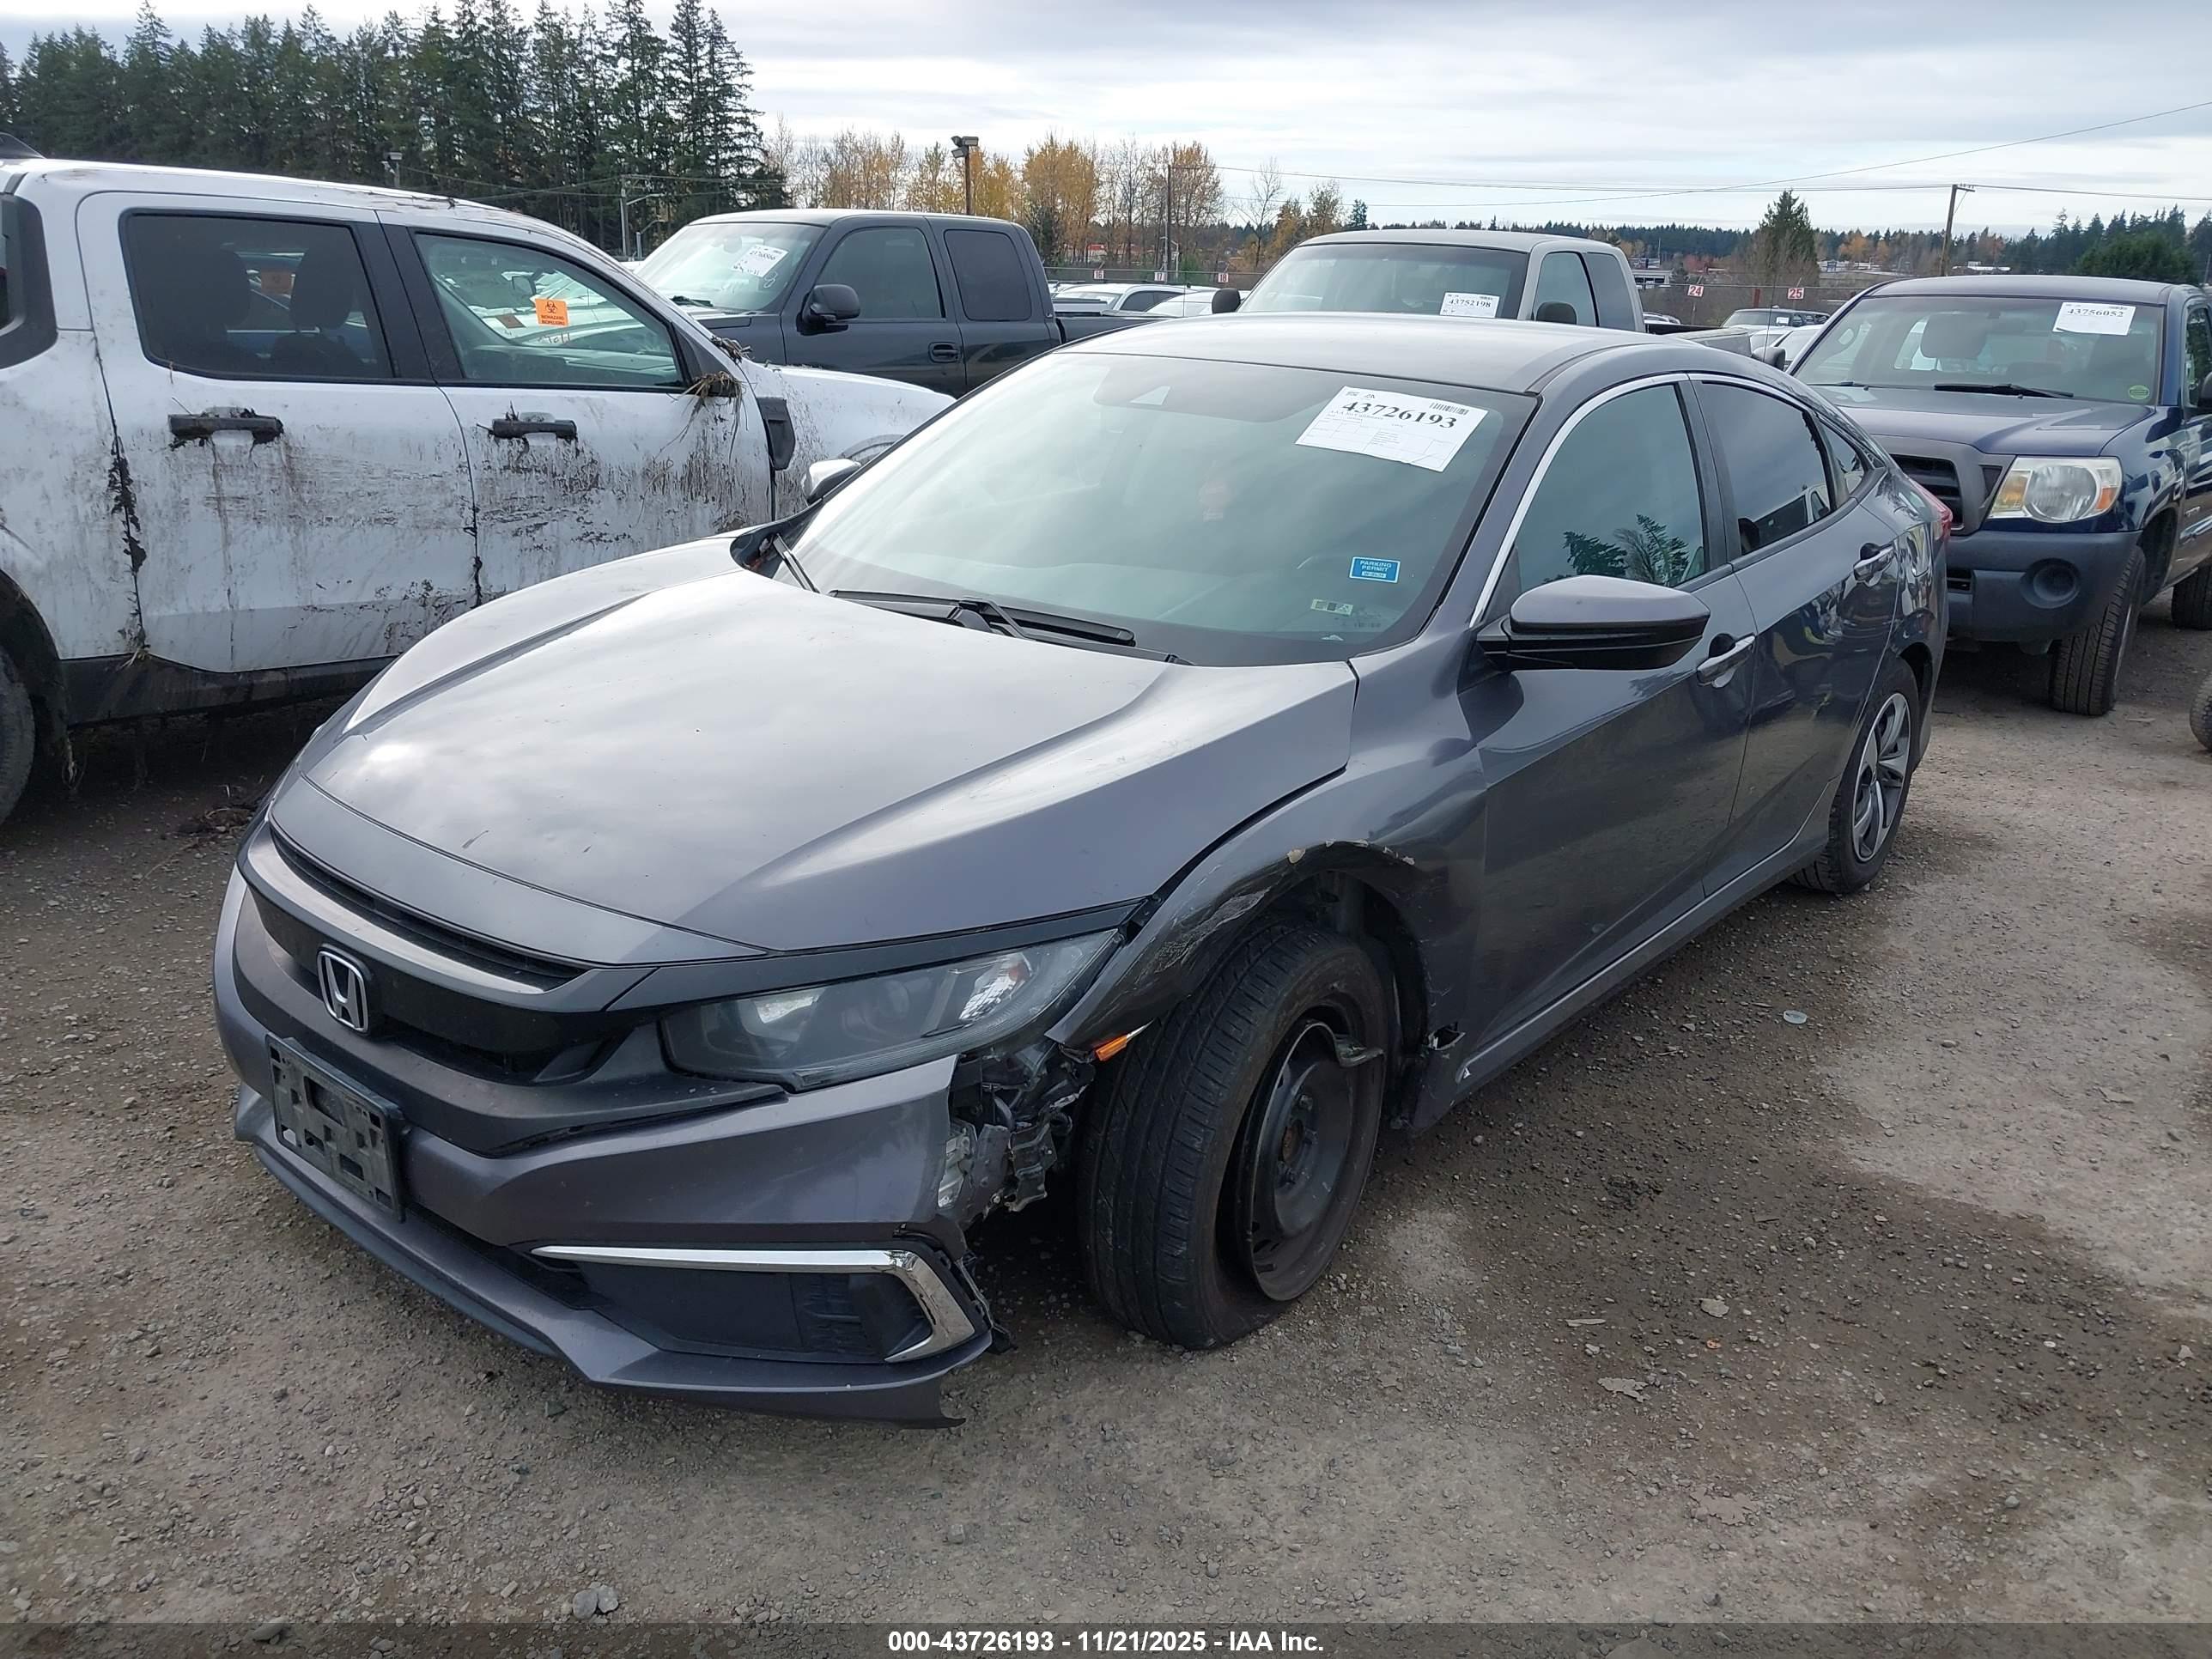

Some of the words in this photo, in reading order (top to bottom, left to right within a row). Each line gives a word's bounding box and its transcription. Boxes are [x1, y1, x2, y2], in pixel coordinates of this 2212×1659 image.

[1690, 286, 1702, 295] 24
[1790, 289, 1802, 299] 25
[1449, 299, 1491, 307] 43752198
[2067, 308, 2124, 318] 43756052
[1342, 400, 1457, 428] 43726193
